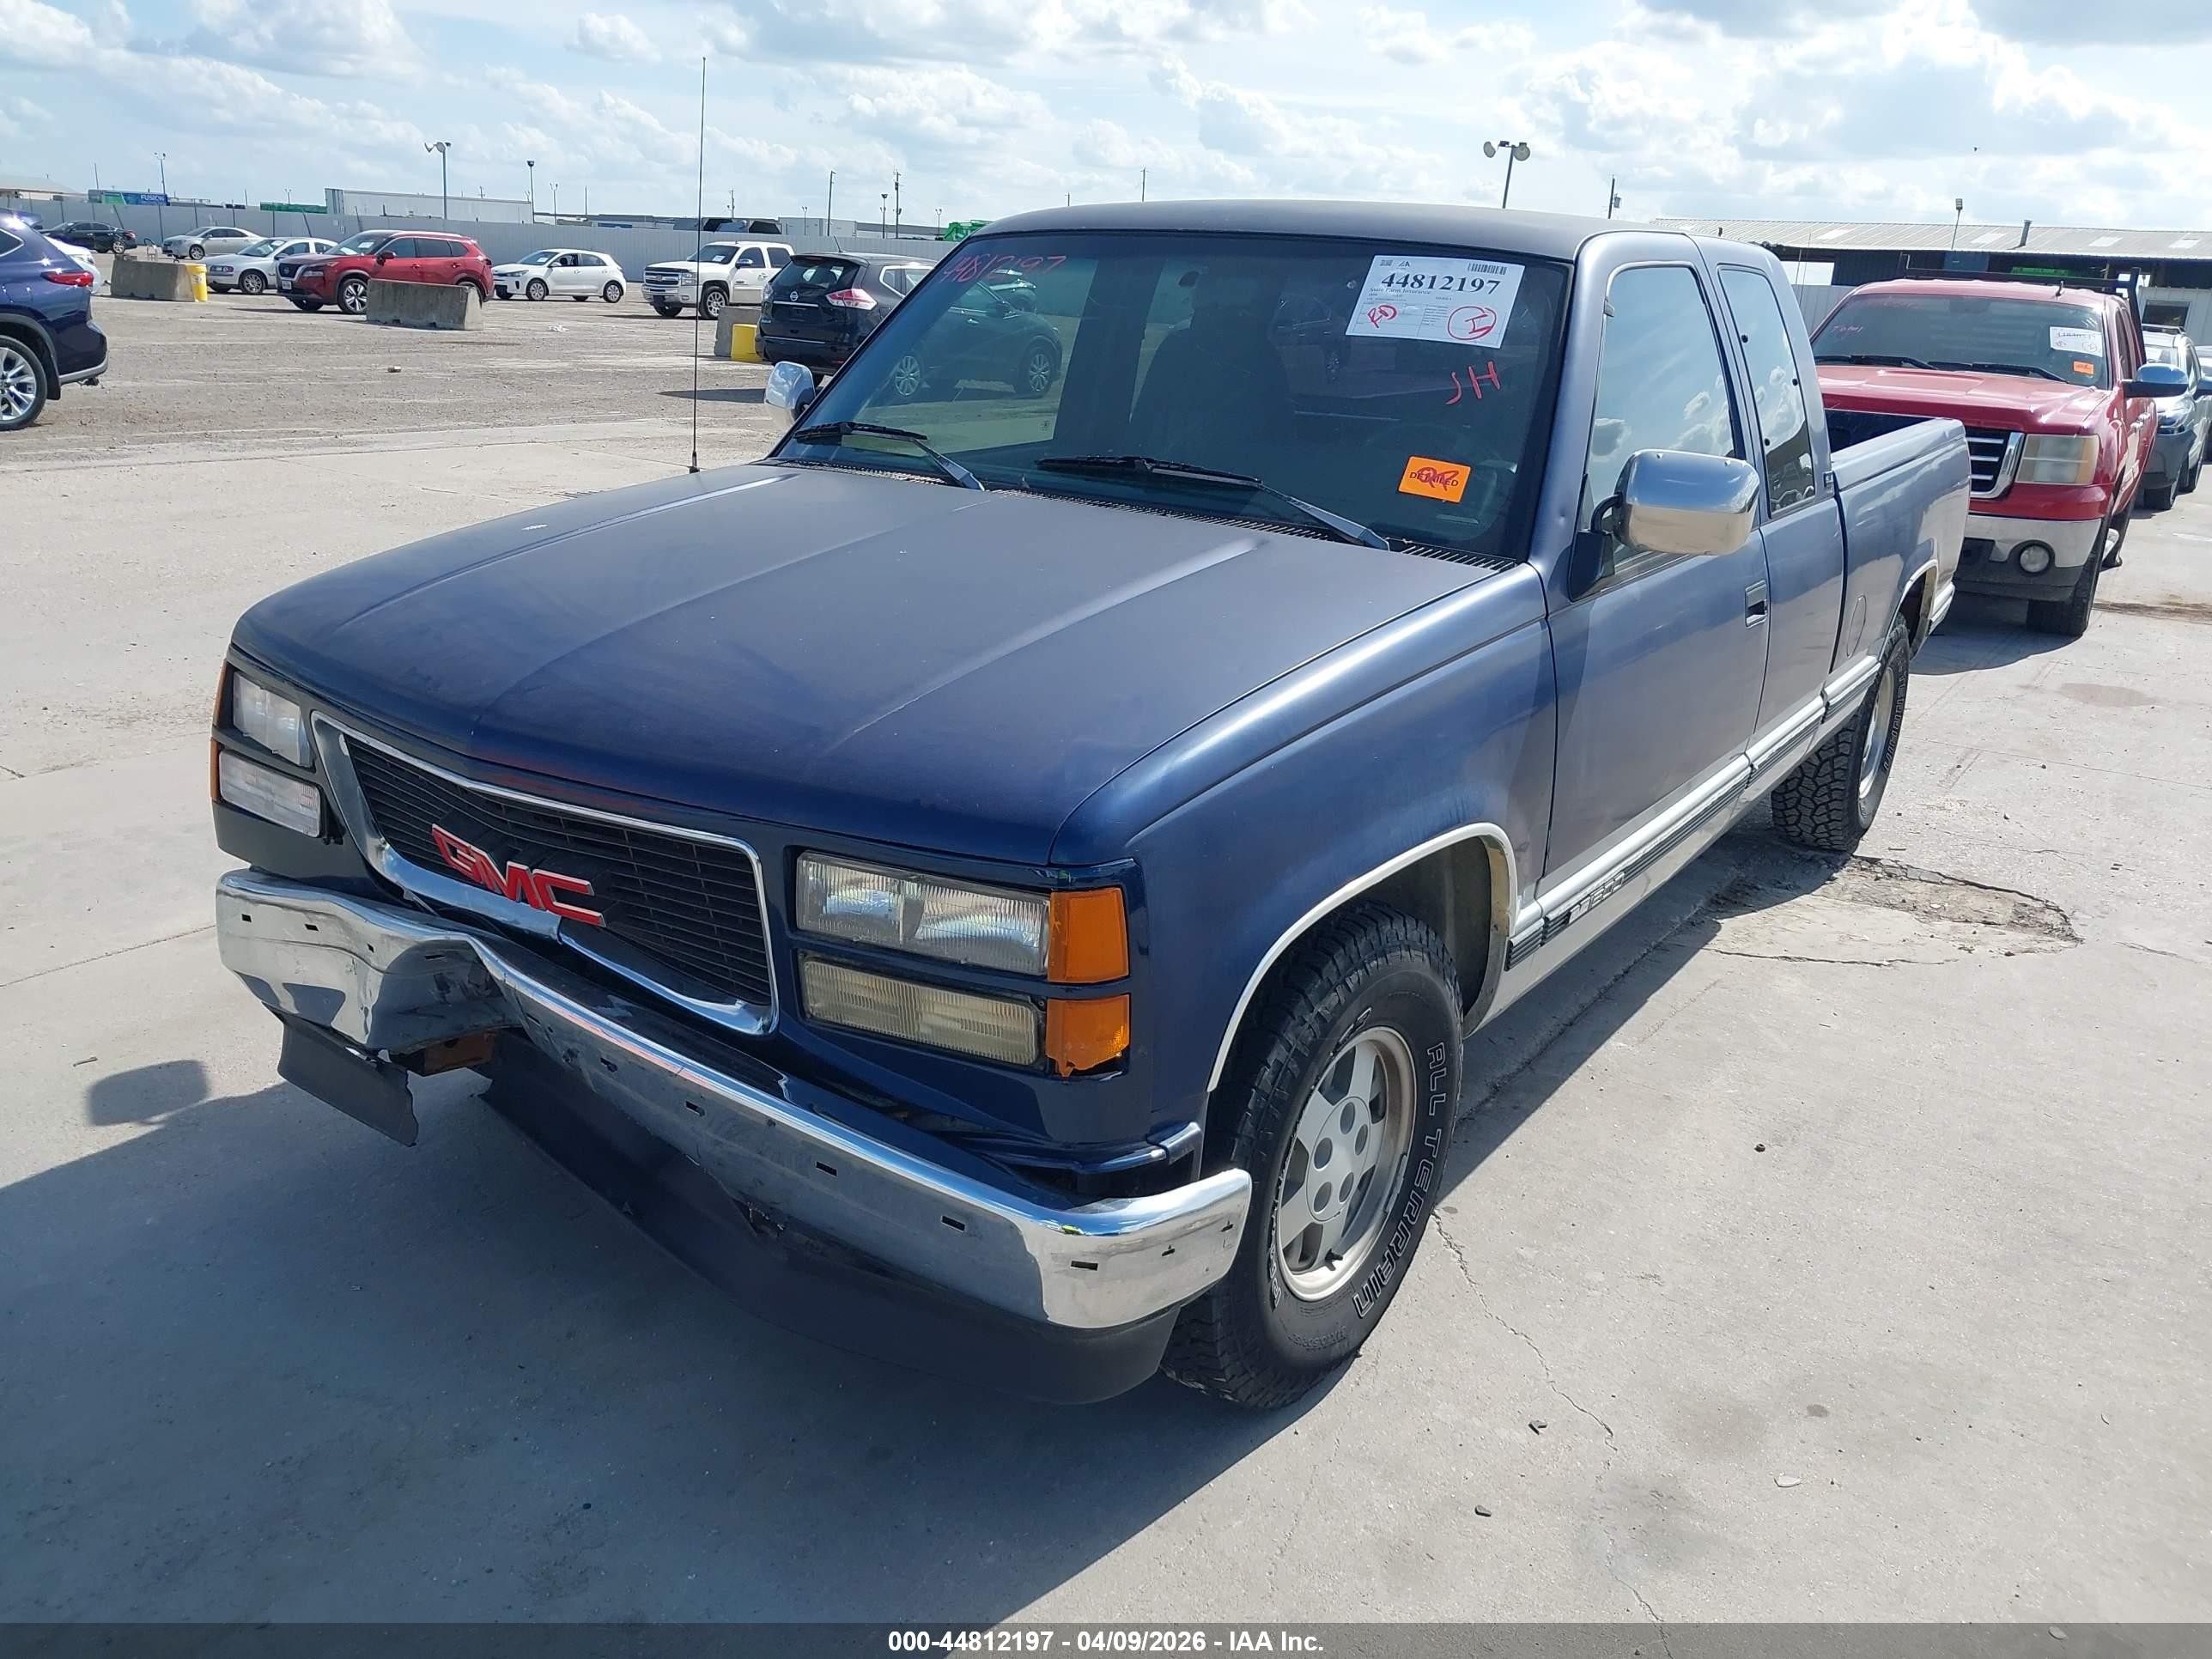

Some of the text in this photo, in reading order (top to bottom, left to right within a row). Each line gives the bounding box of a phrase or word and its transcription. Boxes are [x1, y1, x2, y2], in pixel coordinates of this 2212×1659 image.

[1381, 272, 1501, 295] 44812197
[432, 823, 606, 927] GMC
[1352, 1042, 1446, 1319] ALL TERRAIN
